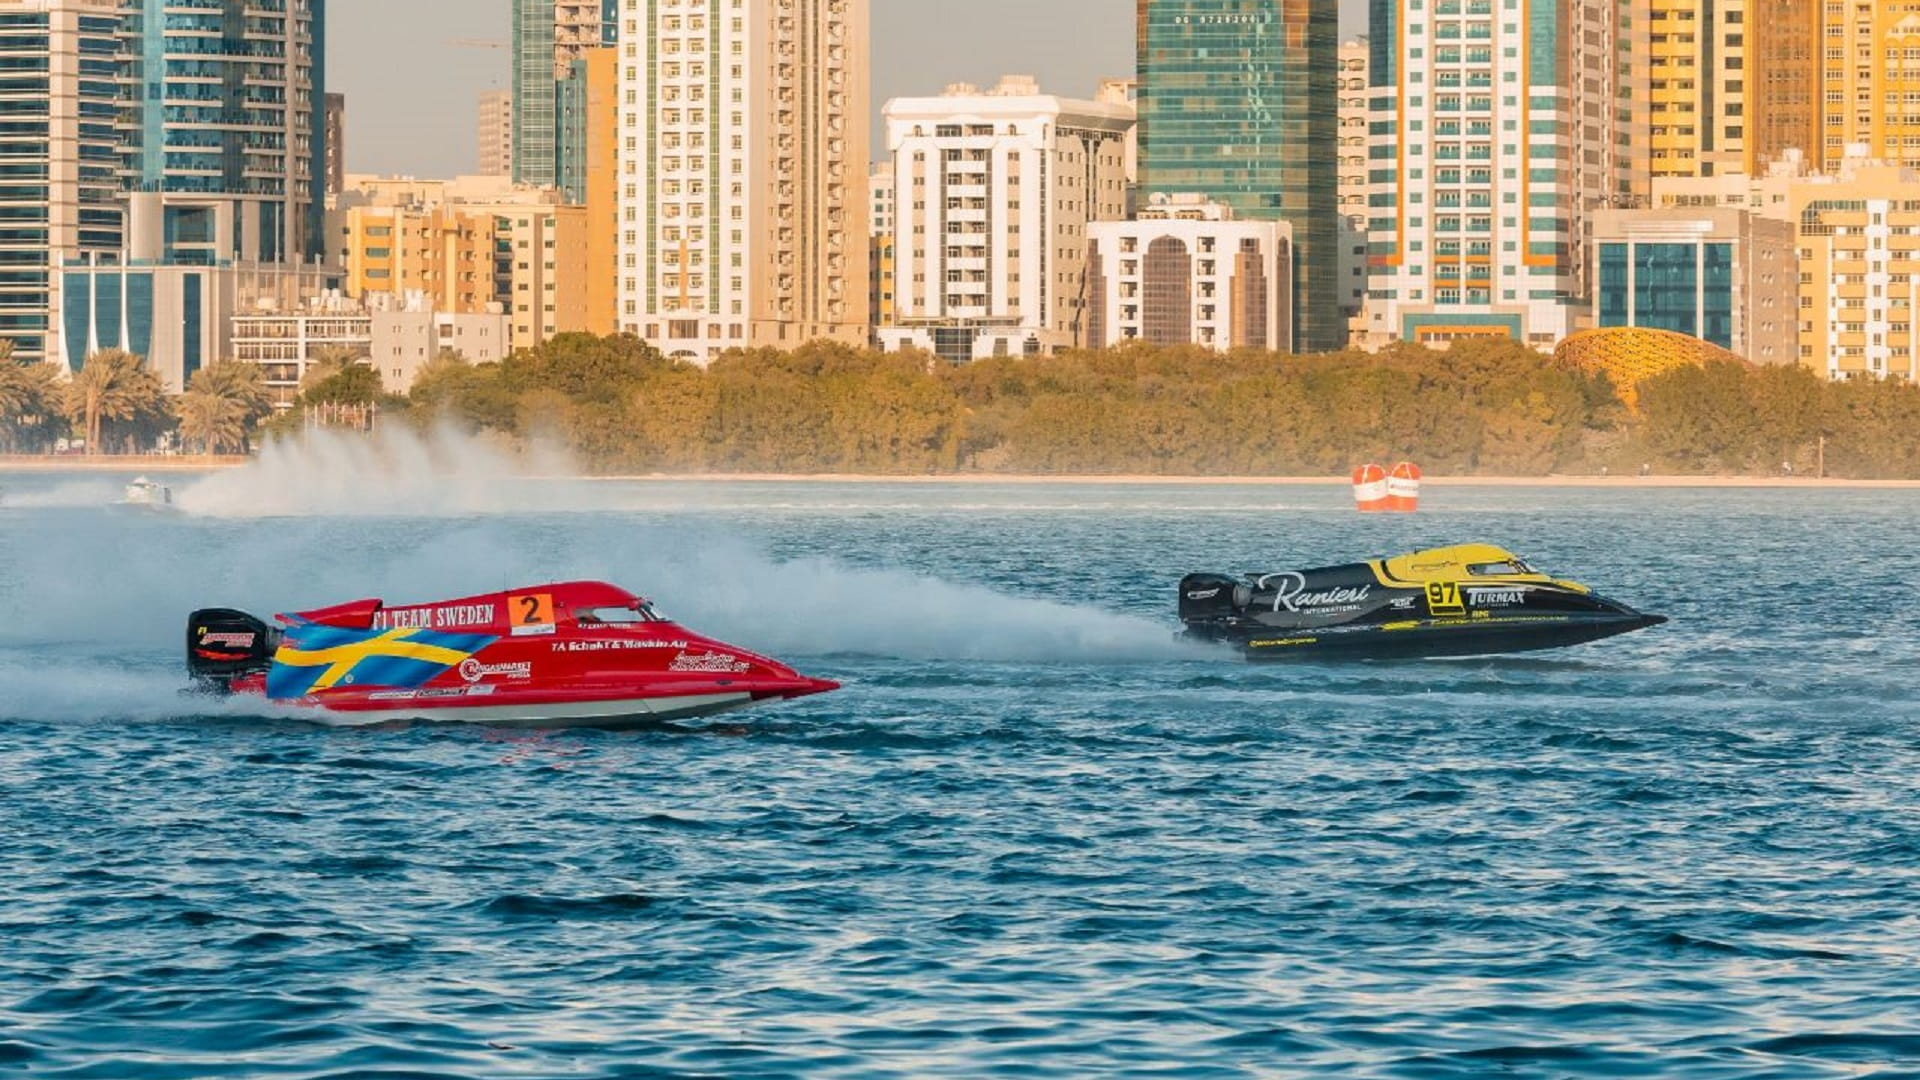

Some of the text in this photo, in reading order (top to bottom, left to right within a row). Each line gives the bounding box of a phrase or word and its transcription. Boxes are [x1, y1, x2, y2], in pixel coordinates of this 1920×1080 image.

[1258, 571, 1371, 612] Ranieri
[1429, 583, 1455, 604] 97
[373, 604, 494, 630] F1 TEAM SWEDEN
[520, 596, 542, 624] 2
[1303, 604, 1361, 615] INTERNATIONAL
[611, 640, 621, 649] &
